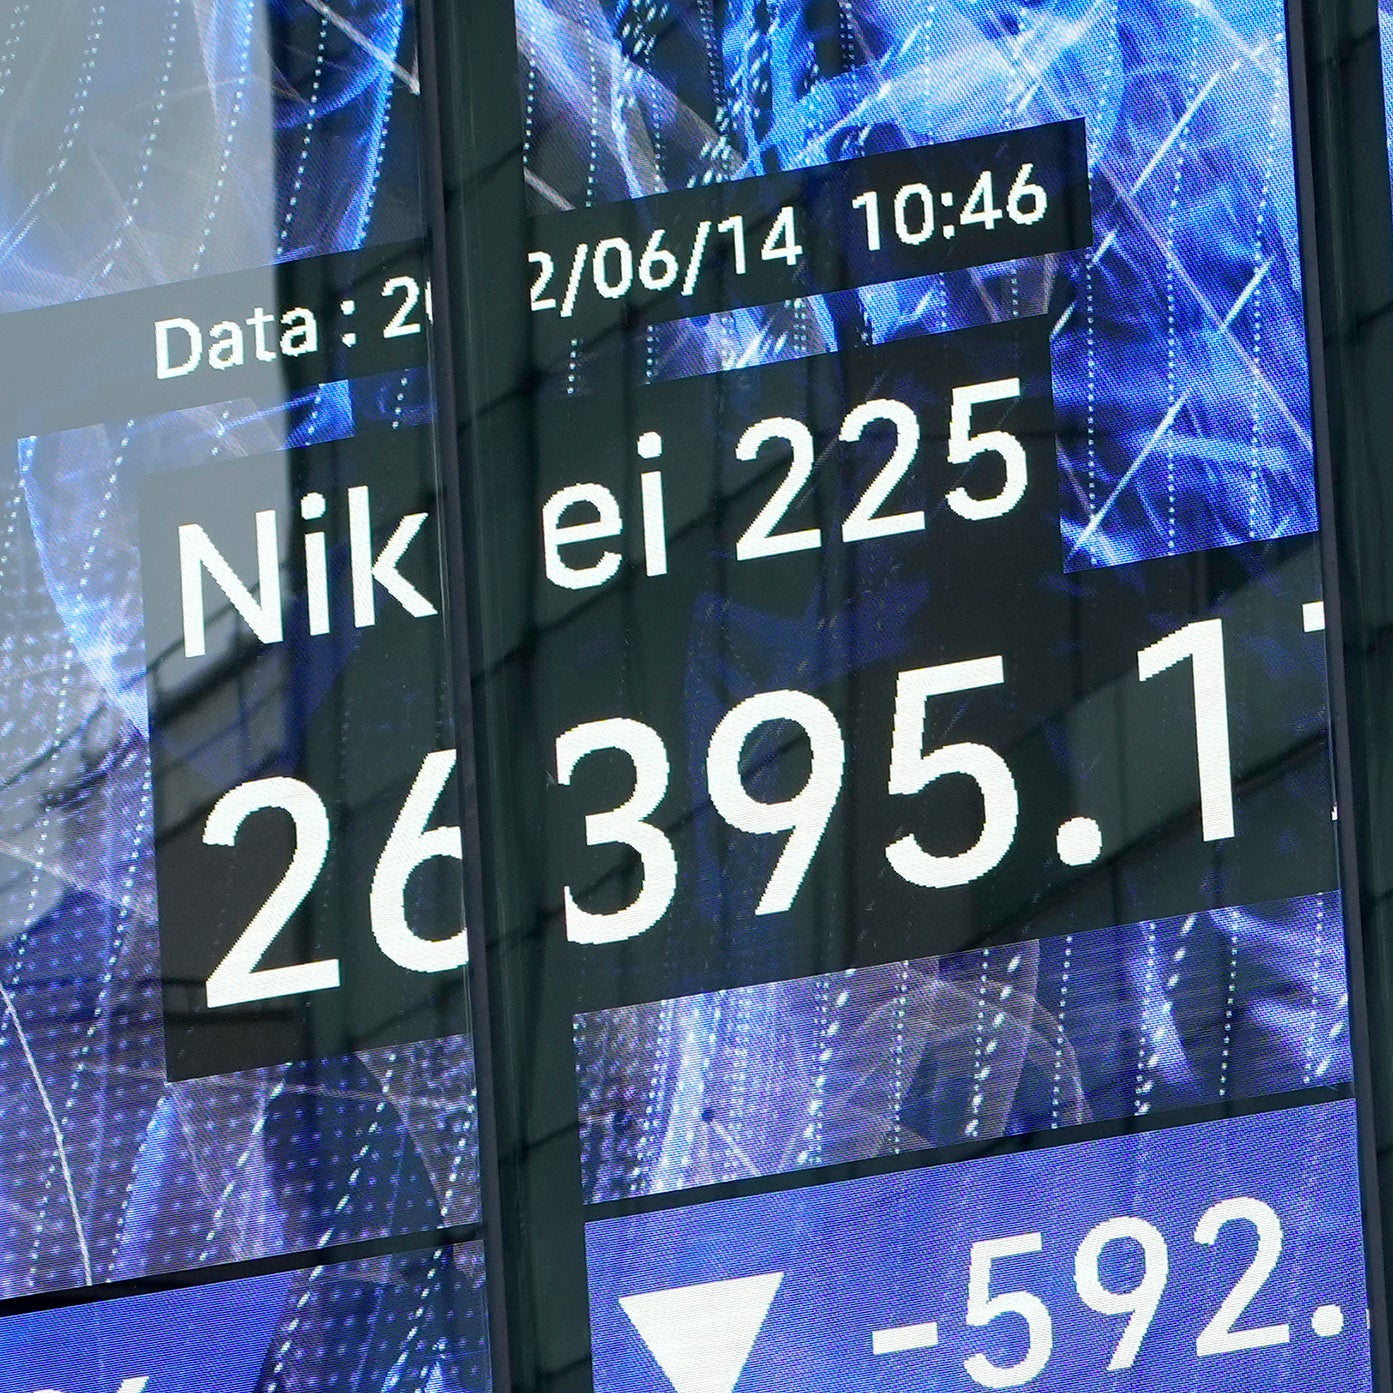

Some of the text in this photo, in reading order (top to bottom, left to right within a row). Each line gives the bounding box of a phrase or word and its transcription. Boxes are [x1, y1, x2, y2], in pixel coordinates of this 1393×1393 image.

[853, 164, 1046, 250] 10:46
[178, 378, 1027, 658] Nikei 225
